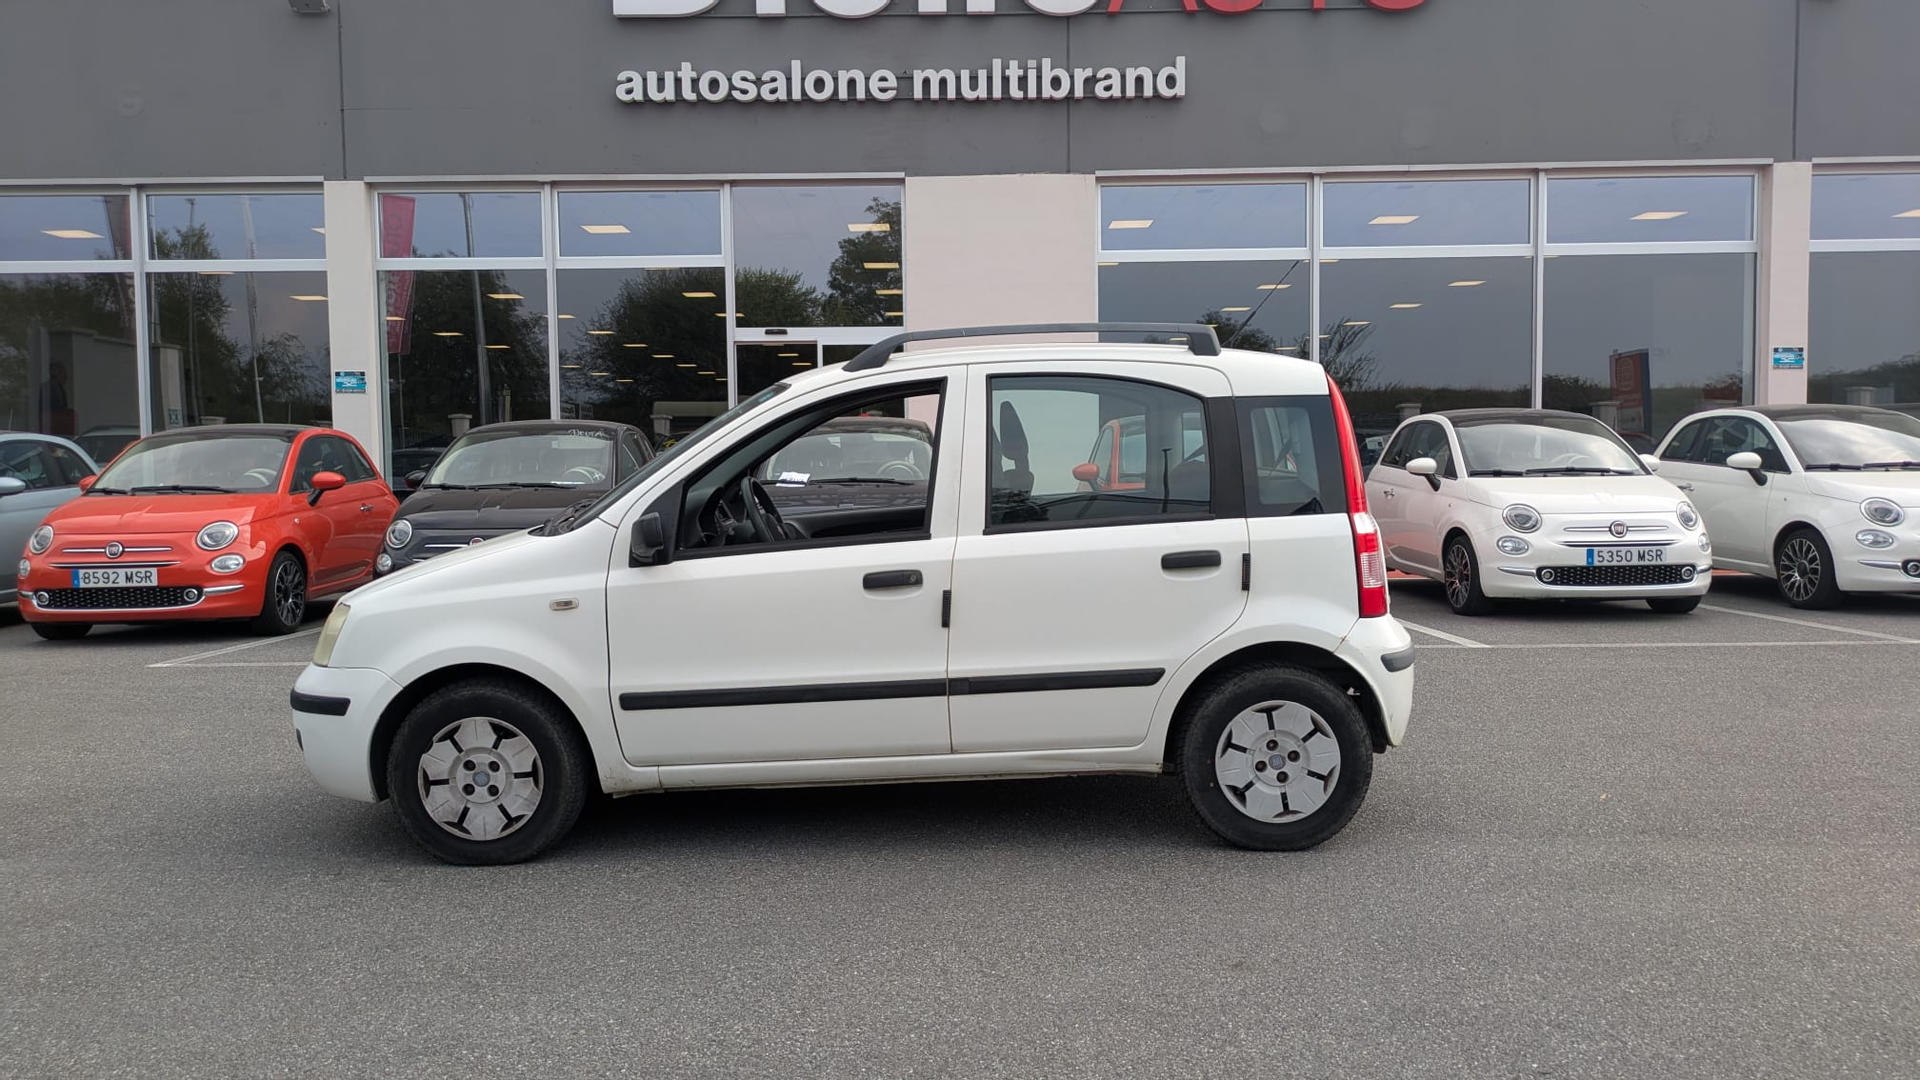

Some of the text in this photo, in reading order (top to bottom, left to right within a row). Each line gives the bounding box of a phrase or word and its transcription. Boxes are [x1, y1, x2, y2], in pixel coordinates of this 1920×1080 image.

[615, 56, 1186, 101] autosalone multibrand
[1597, 549, 1663, 563] 5350 MSR
[82, 570, 153, 585] 8592 MSR
